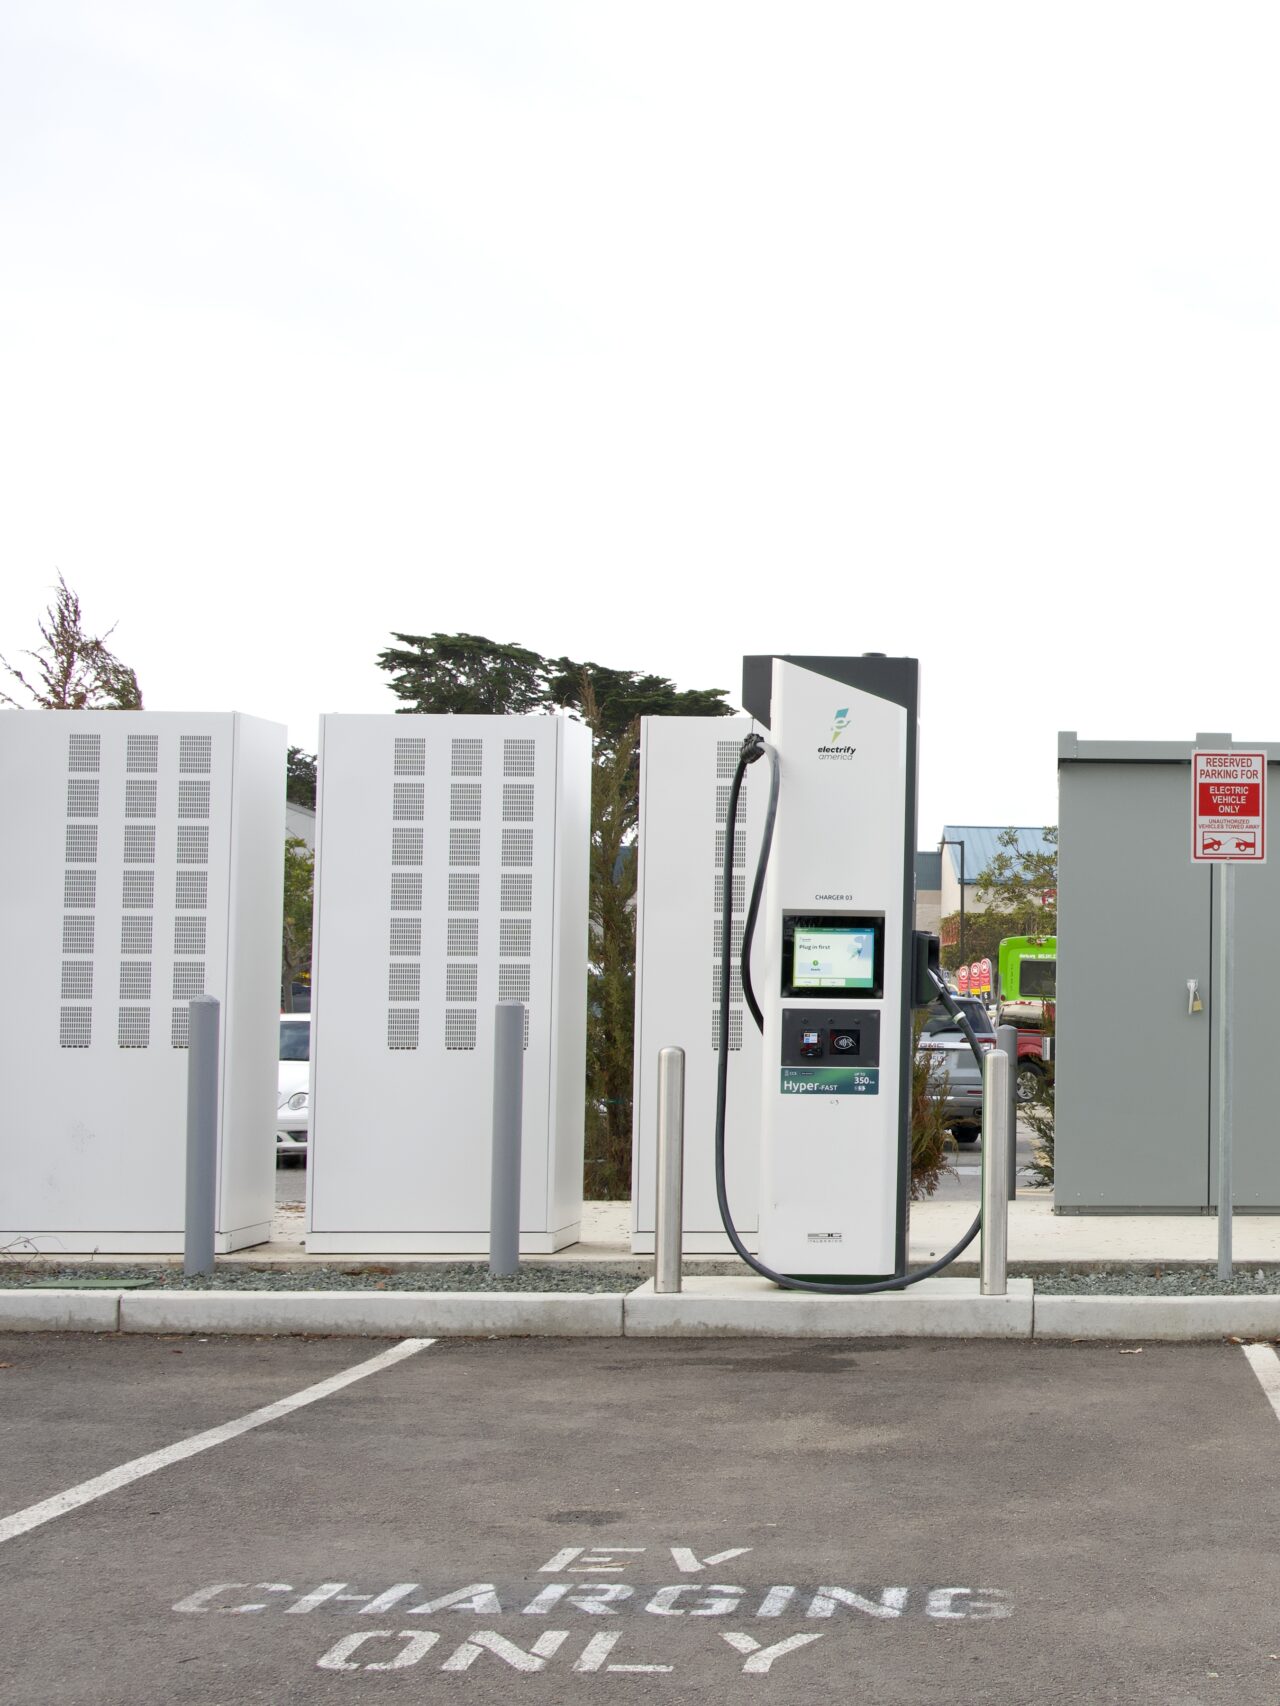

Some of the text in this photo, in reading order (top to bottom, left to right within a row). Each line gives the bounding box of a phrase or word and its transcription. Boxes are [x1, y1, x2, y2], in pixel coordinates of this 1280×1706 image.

[818, 746, 856, 755] electrify
[1206, 758, 1253, 768] RESERVED
[1200, 769, 1259, 779] PARKING FOR
[1209, 786, 1249, 794] ELECTRIC
[1212, 796, 1247, 804] VEHICLE
[1218, 805, 1240, 813] ONLY
[784, 1080, 838, 1093] Hyper-FAST
[854, 1076, 870, 1085] 350
[537, 1547, 753, 1572] EV
[171, 1582, 1016, 1620] CHARGING
[316, 1630, 824, 1673] ONLY
